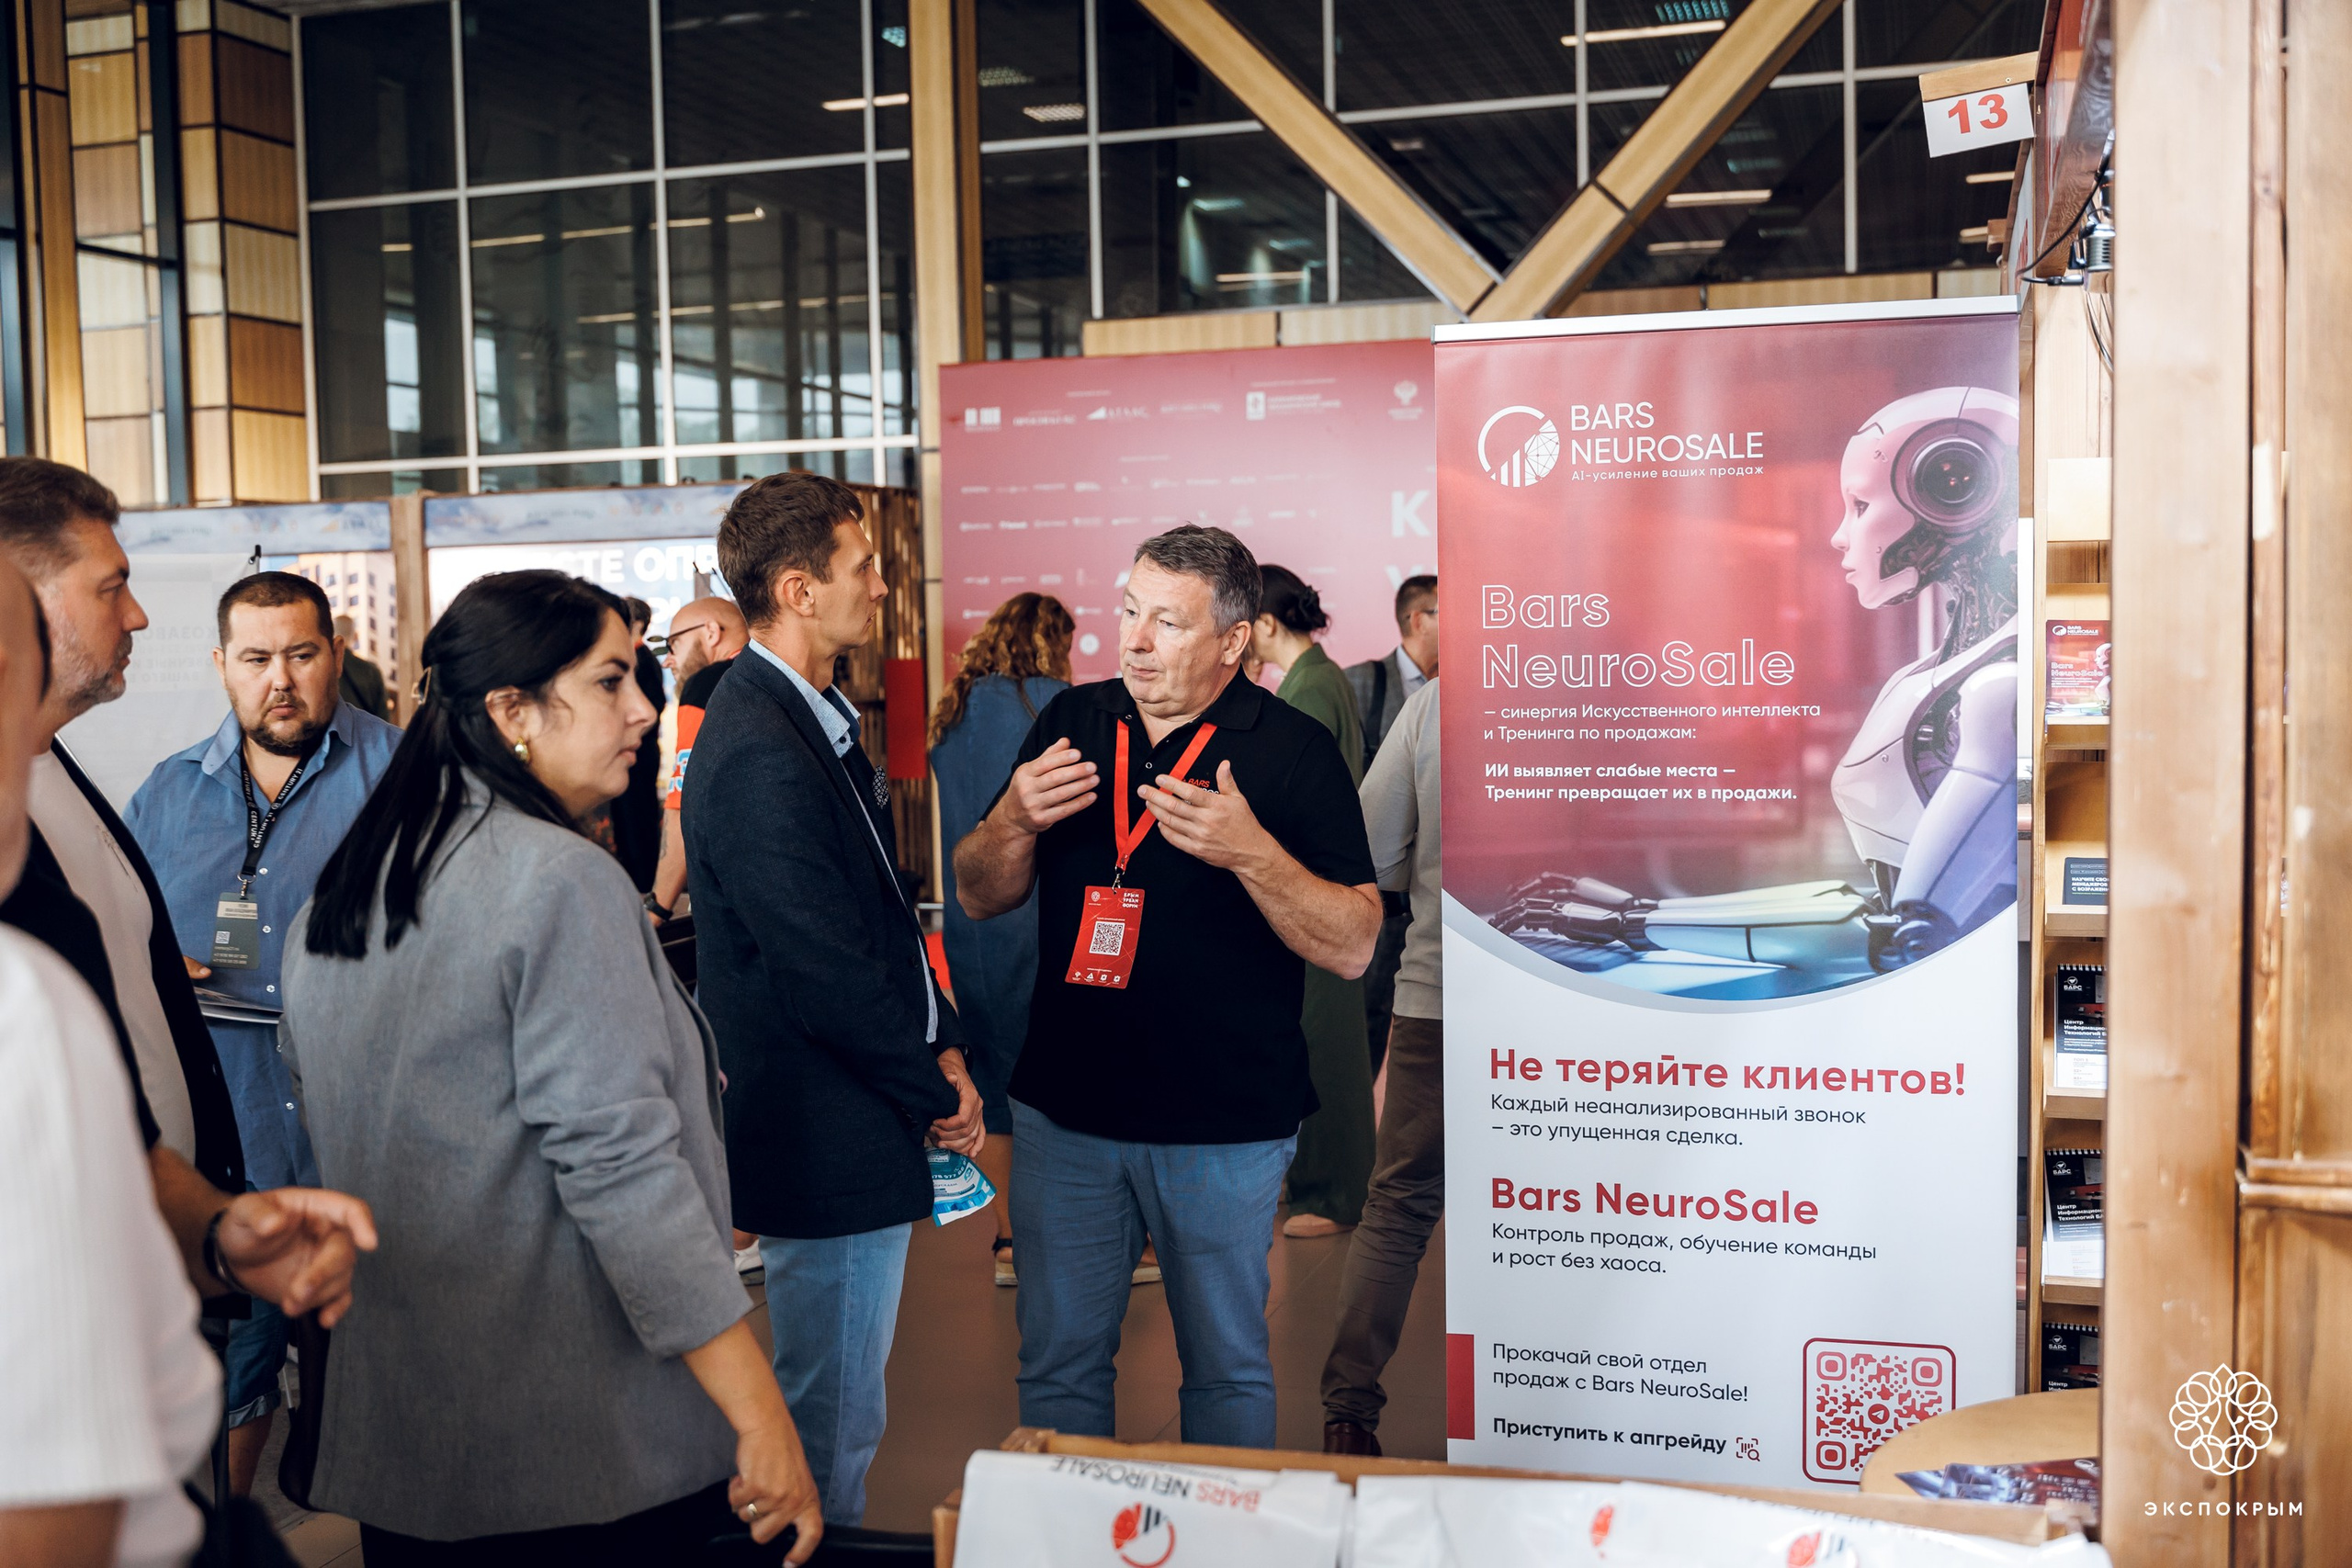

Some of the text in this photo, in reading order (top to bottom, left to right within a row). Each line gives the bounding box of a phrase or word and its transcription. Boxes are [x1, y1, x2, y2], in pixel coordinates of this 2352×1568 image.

[1949, 94, 2008, 134] 13
[1571, 401, 1656, 431] BARS
[1572, 431, 1767, 466] NEUROSALE
[1572, 465, 1763, 484] AI-усиление ваших продаж
[1482, 585, 1610, 628] Bars
[1483, 638, 1794, 688] NeuroSale
[1501, 708, 1577, 721] синергия
[1582, 705, 1717, 720] Искусственного
[1722, 705, 1820, 716] интеллекта
[1485, 727, 1696, 742] и Тренинга по продажам:
[1486, 763, 1508, 776] ИИ
[1514, 767, 1591, 777] выявляет
[1596, 763, 1661, 777] слабые
[1667, 767, 1717, 777] места
[277, 774, 299, 800] CENTURY
[1485, 785, 1796, 802] Тренинг превращает их в продажи.
[1491, 1048, 1964, 1095] Не теряйте клиентов!
[1492, 1094, 1865, 1123] Каждый неанализированный звонок
[1510, 1124, 1542, 1136] это
[1548, 1126, 1659, 1142] упущенная
[1667, 1131, 1742, 1145] сделка.
[1492, 1178, 1818, 1224] Bars NeuroSale
[1493, 1224, 1875, 1260] Контроль продаж, обучение команды
[1493, 1252, 1666, 1272] и рост без хаоса.
[1494, 1344, 1706, 1374] Прокачай свой отдел
[1494, 1372, 1747, 1401] продаж с Bars NeuroSale!
[1494, 1418, 1726, 1454] Приступить к апгрейду
[1196, 1480, 1261, 1512] BARS
